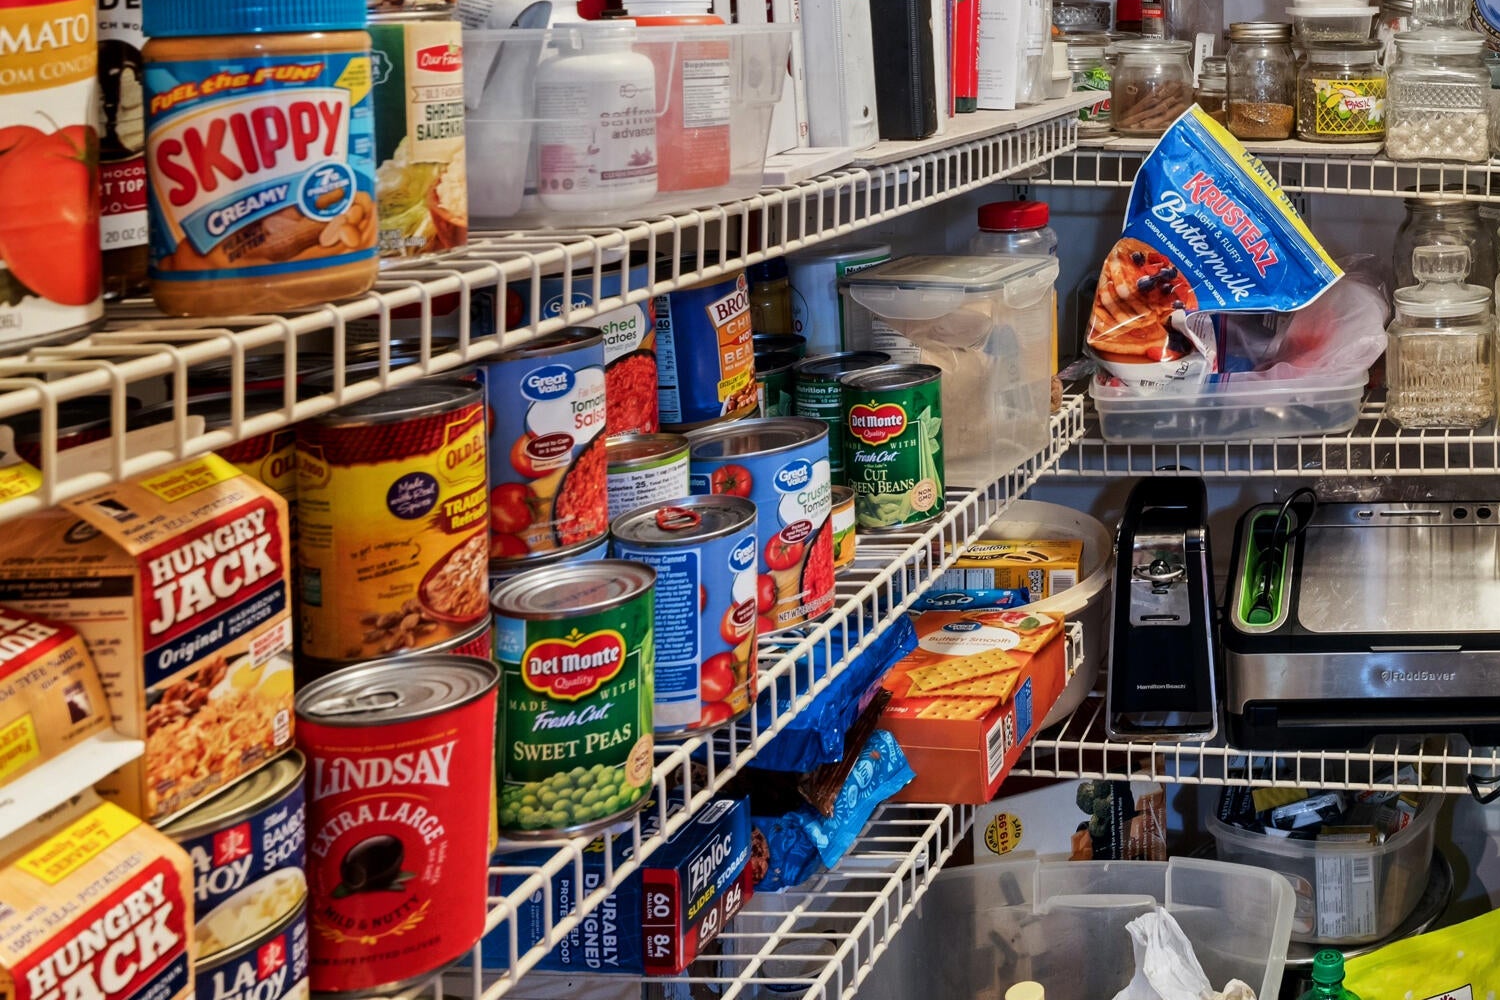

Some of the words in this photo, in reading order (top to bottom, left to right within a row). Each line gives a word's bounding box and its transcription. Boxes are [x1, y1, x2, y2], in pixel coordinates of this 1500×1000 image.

[151, 82, 199, 115] FUEL
[201, 70, 251, 95] the
[253, 61, 325, 84] FUN!
[1343, 97, 1373, 112] BASIL
[156, 101, 343, 207] SKIPPY
[1242, 151, 1280, 192] FAMILY
[206, 182, 290, 236] CREAMY
[105, 227, 121, 243] 20
[1182, 170, 1279, 279] KRUSTEAZ
[1194, 209, 1217, 232] LIGHT
[1213, 229, 1222, 238] &
[1220, 236, 1243, 264] FLUFFY
[1151, 189, 1256, 303] Buttermilk
[1144, 218, 1168, 243] COMPLETE
[1165, 238, 1186, 261] PANCAKE
[1202, 278, 1215, 293] ADD
[1211, 288, 1227, 307] WATER
[527, 371, 568, 389] Great
[536, 381, 568, 395] Value
[852, 413, 871, 427] Del
[872, 413, 904, 428] Monte
[863, 429, 887, 439] Quality
[890, 438, 918, 450] WITH
[854, 450, 878, 464] Fresh
[778, 464, 809, 482] Great
[786, 474, 809, 488] Value
[863, 468, 888, 482] CUT
[878, 477, 916, 494] BEANS
[916, 487, 932, 497] NON
[917, 493, 934, 503] GMO
[148, 508, 268, 588] HUNGRY
[150, 533, 279, 636] JACK
[228, 604, 273, 637] POTATOES
[158, 622, 224, 671] Original
[928, 636, 968, 646] Buttery
[970, 635, 1012, 645] Smooth
[529, 656, 558, 676] Del
[561, 645, 621, 672] Monte
[553, 674, 594, 689] Quality
[600, 678, 637, 700] WITH
[1392, 671, 1456, 681] FoodSaver
[508, 699, 548, 713] MADE
[532, 709, 577, 733] Fresh
[513, 738, 580, 762] SWEET
[584, 722, 632, 755] PEAS
[311, 803, 373, 859] EXTRA
[377, 802, 445, 846] LARGE
[986, 823, 998, 849] GREAT
[997, 812, 1009, 852] $19.99
[690, 831, 733, 892] Ziploc
[687, 884, 716, 921] SLIDER
[716, 847, 748, 890] STORAGE
[323, 904, 357, 930] MILD
[358, 920, 368, 931] &
[371, 894, 420, 929] NUTTY
[653, 892, 670, 919] 60
[699, 907, 718, 940] 60
[725, 883, 742, 913] 84
[26, 872, 166, 1000] HUNGRY
[653, 933, 671, 959] 84
